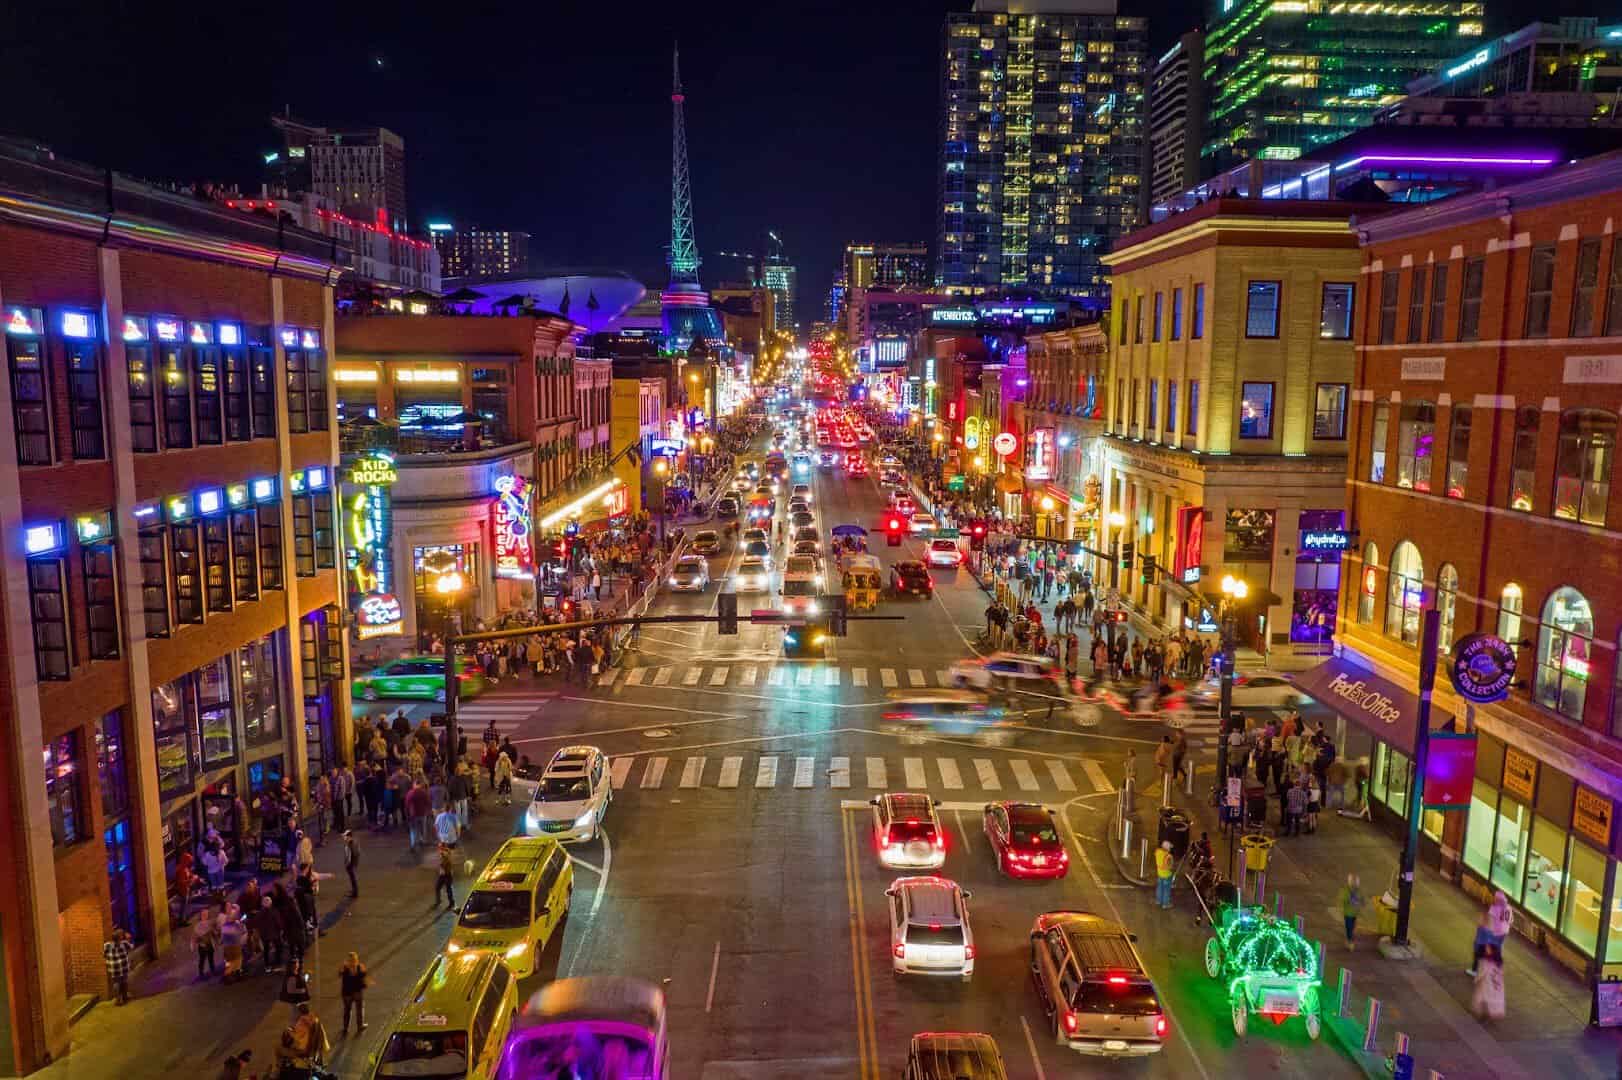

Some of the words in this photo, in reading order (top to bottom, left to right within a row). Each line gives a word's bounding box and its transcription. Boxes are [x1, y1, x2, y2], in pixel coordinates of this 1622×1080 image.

[362, 460, 389, 471] KID
[1464, 641, 1482, 656] THE
[1459, 672, 1511, 695] COLLECTION
[1328, 672, 1369, 705] FedEx
[1361, 692, 1401, 723] Office
